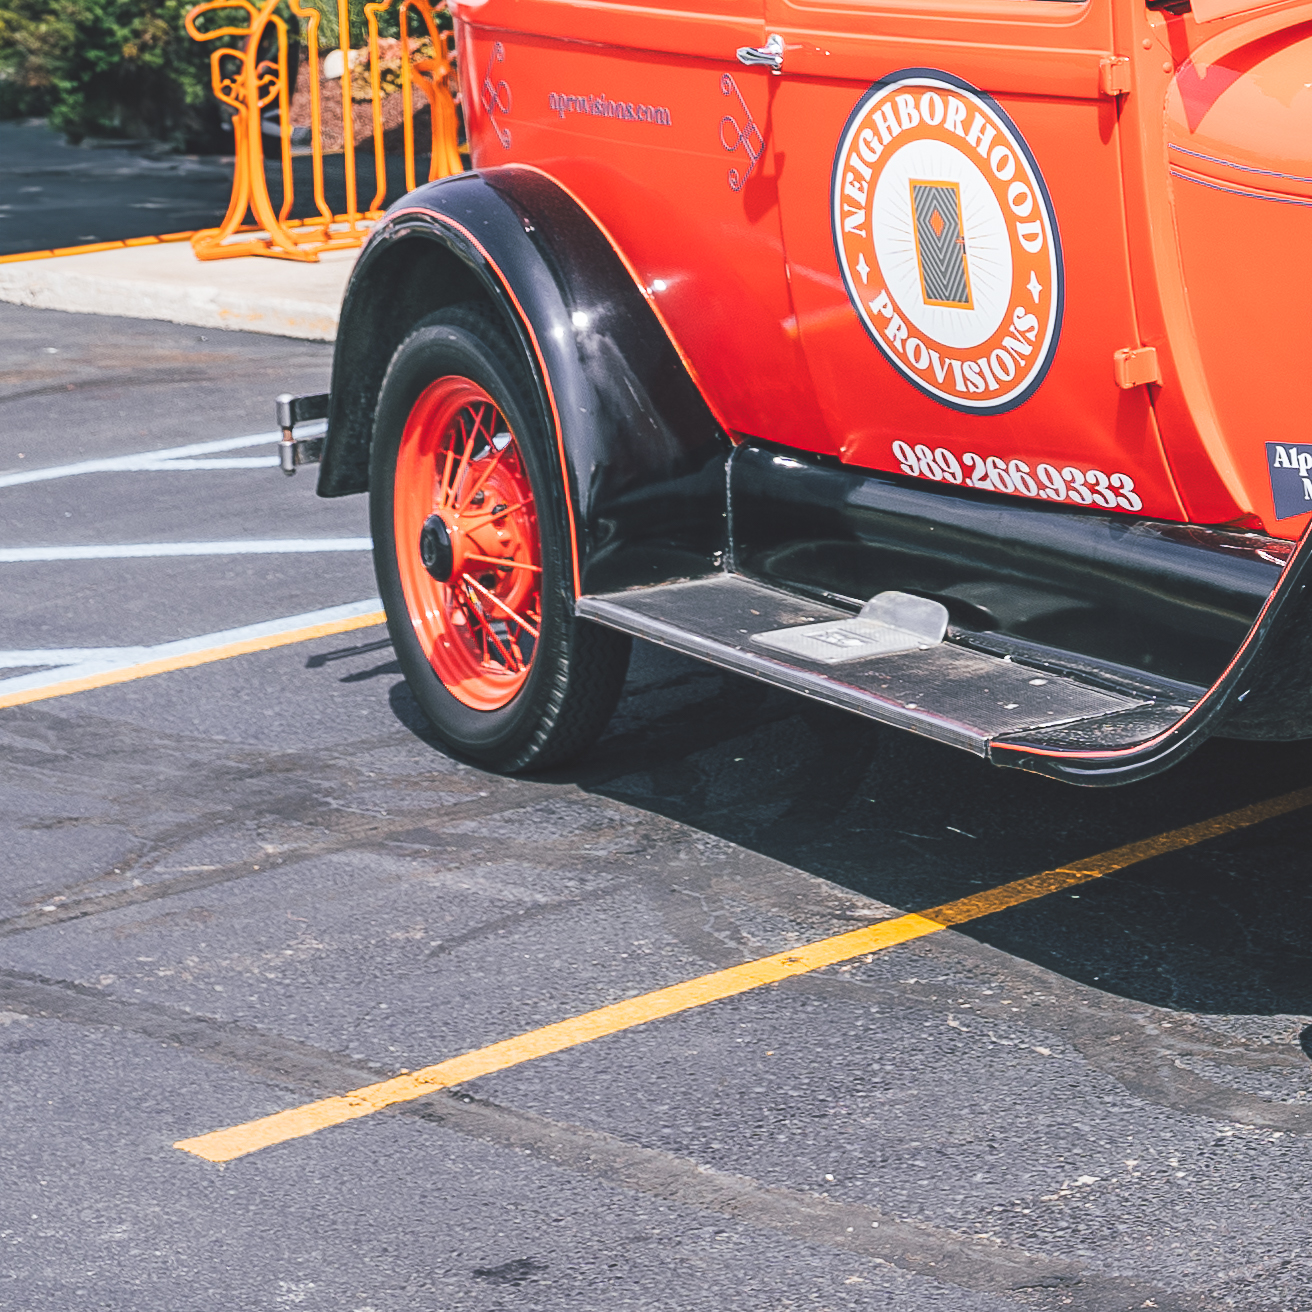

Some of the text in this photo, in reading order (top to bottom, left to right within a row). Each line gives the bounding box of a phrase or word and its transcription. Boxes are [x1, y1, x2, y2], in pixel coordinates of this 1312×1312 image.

[549, 90, 673, 127] nprovisions.com
[843, 91, 1044, 254] NEIGHBORHOOD
[868, 289, 1040, 394] PROVISIONS
[891, 439, 1144, 512] 989.266.9333
